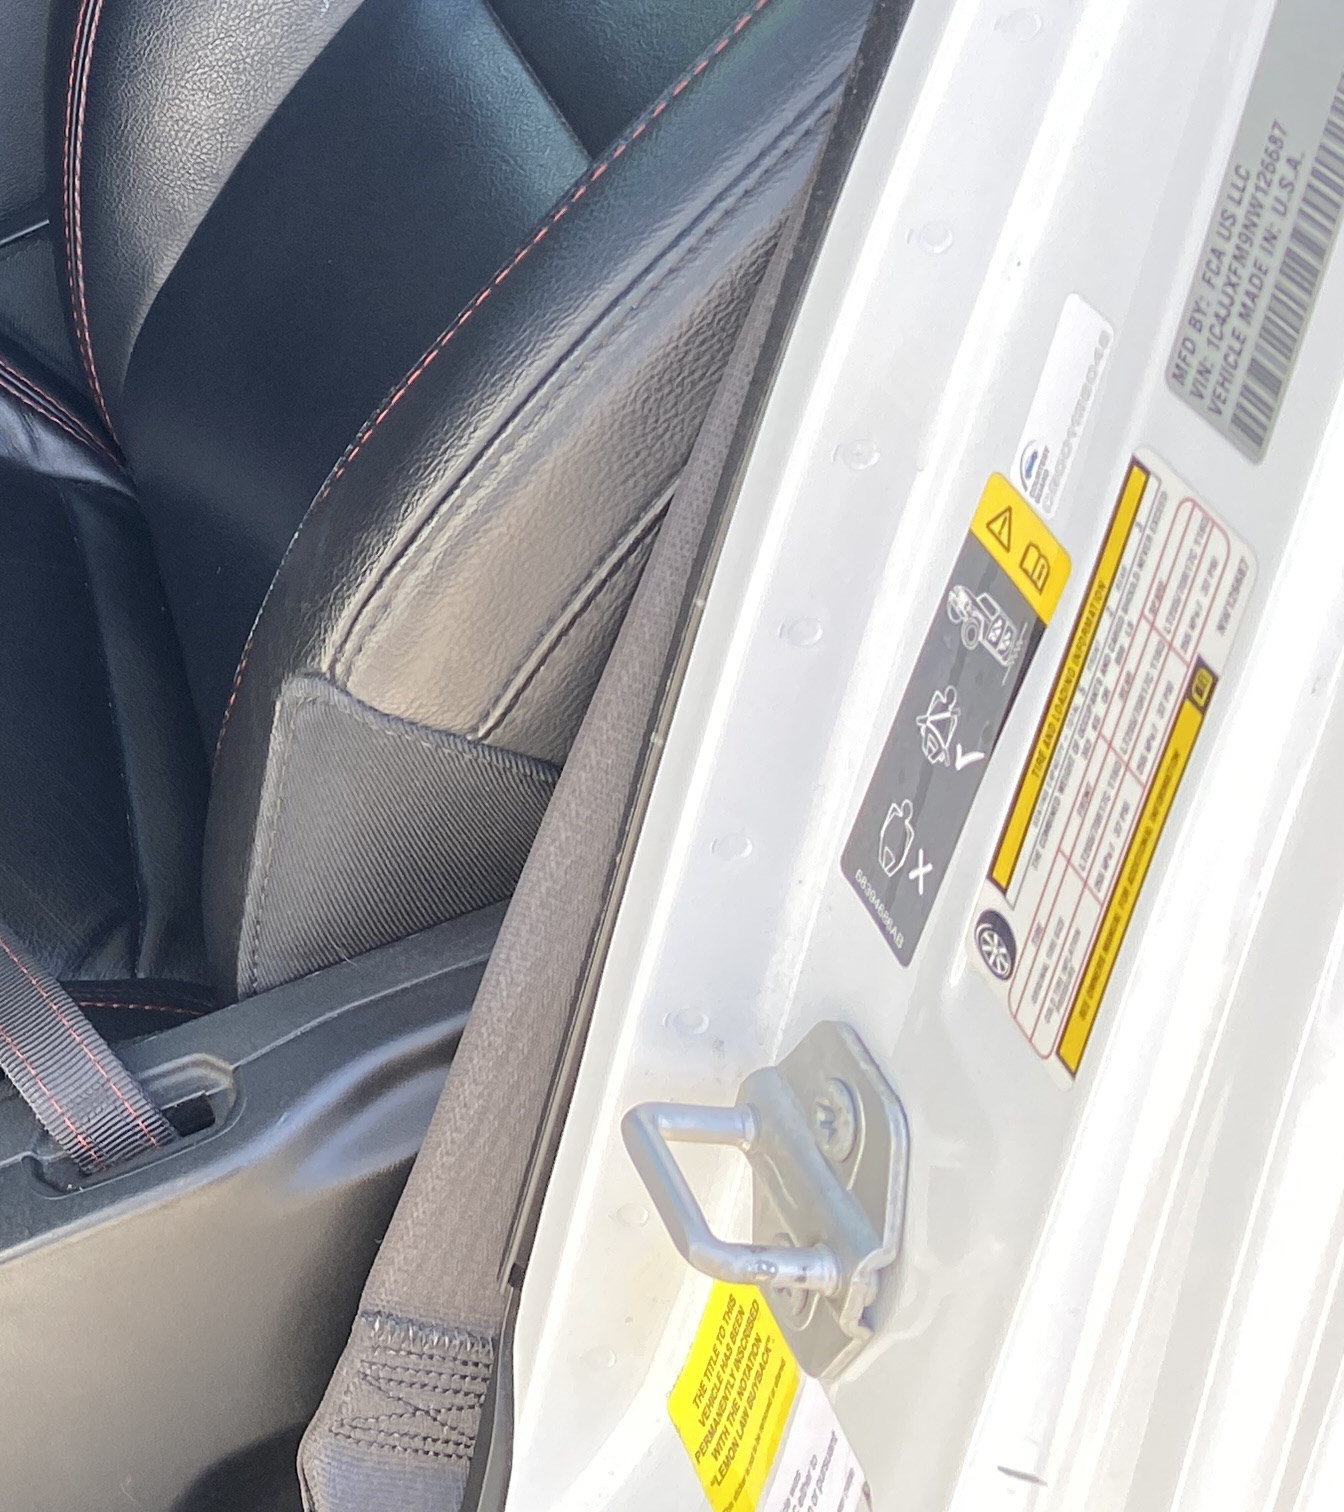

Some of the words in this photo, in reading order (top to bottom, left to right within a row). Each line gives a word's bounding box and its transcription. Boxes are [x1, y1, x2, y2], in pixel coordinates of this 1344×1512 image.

[1226, 163, 1250, 207] LLC
[1216, 208, 1237, 243] US
[1201, 247, 1225, 289] FCA
[1188, 295, 1210, 333] BY:
[1207, 326, 1247, 417] VEHICLE
[1238, 258, 1270, 326] MADE
[1171, 337, 1196, 386] MFD
[1189, 355, 1214, 400] VIN:
[1031, 748, 1047, 783] TIRE
[1041, 718, 1057, 752] AND
[1051, 662, 1076, 724] LOADING
[1070, 575, 1107, 669] INFORMATION
[692, 1382, 707, 1410] THE
[704, 1344, 720, 1383] TITLE
[724, 1293, 737, 1325] THIS
[698, 1374, 724, 1428] VEHICLE
[720, 1345, 733, 1374] HAS
[694, 1372, 737, 1465] PERMANENTLY
[711, 1426, 730, 1462] WITH
[726, 1399, 741, 1428] THE
[735, 1409, 750, 1438] LAW
